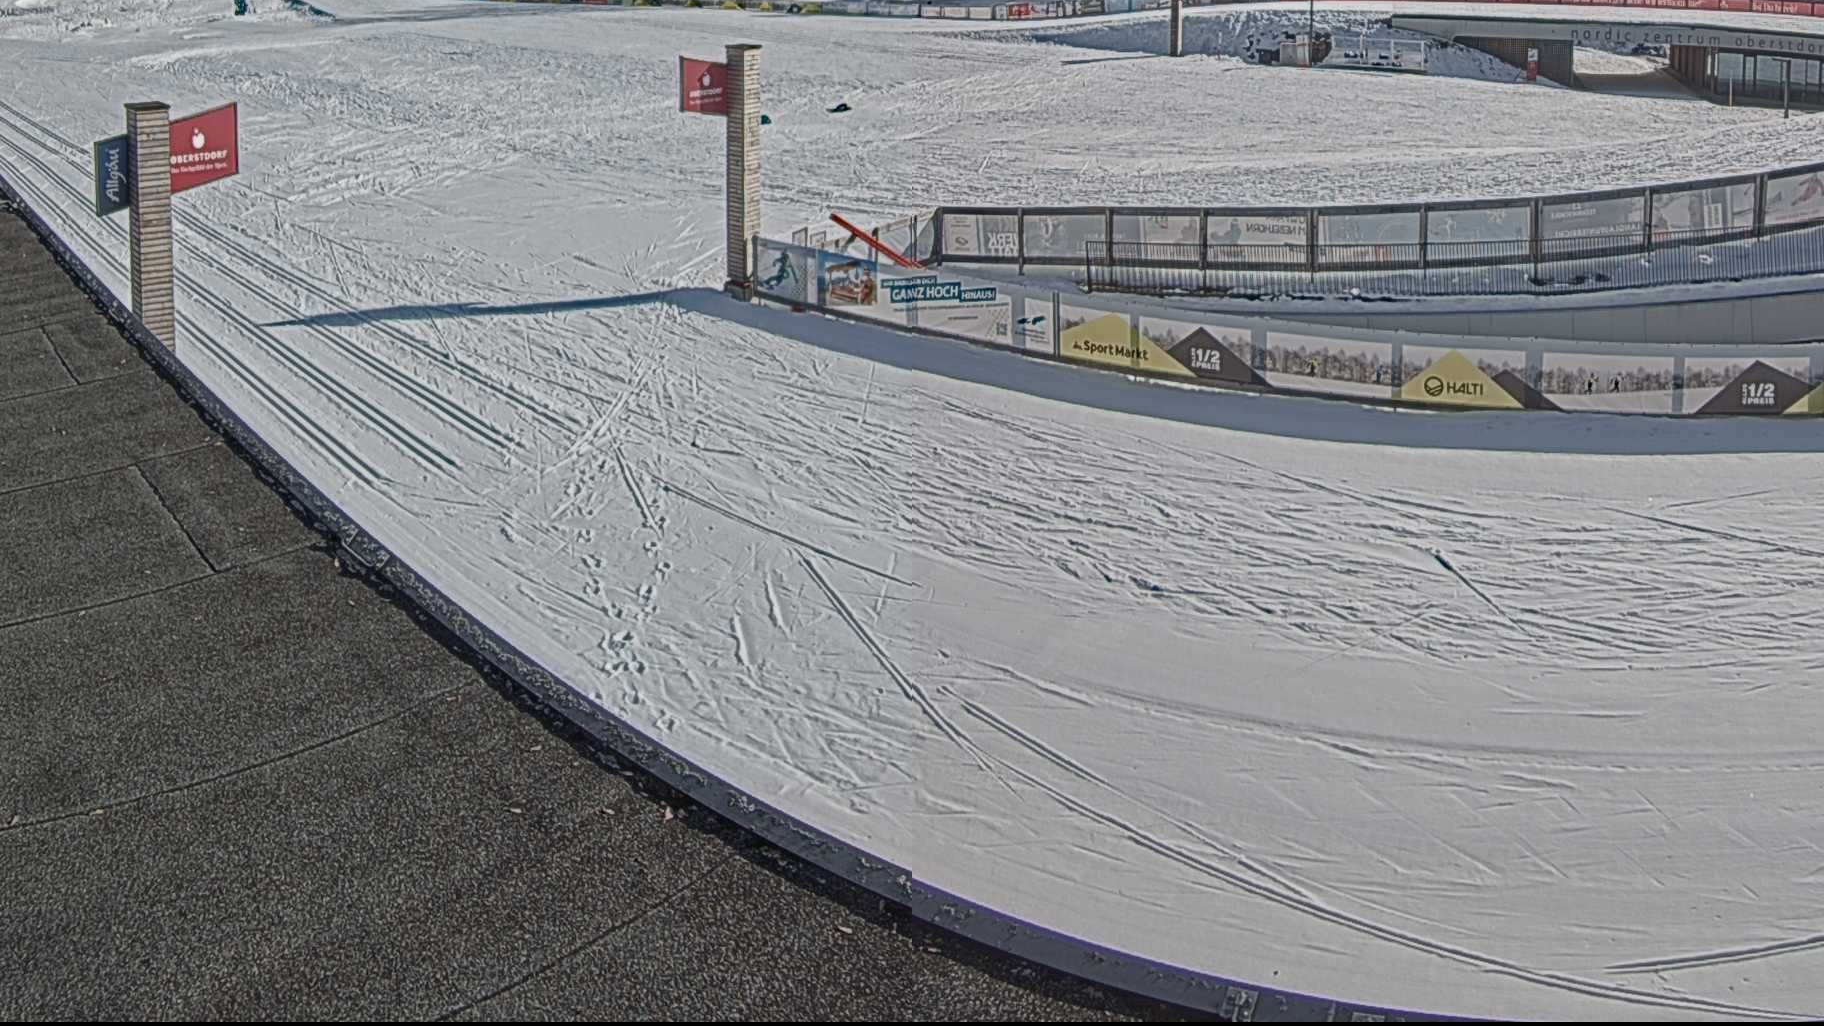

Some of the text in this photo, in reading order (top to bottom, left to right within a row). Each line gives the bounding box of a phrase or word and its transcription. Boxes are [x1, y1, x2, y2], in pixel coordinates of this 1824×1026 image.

[1571, 24, 1631, 42] nordic
[1643, 32, 1721, 46] zentrum
[170, 149, 228, 165] OBERSTDORF
[926, 285, 959, 299] HOCH
[1197, 347, 1220, 362] 1/2
[1446, 381, 1484, 396] HALTI
[1748, 383, 1775, 397] 1/2
